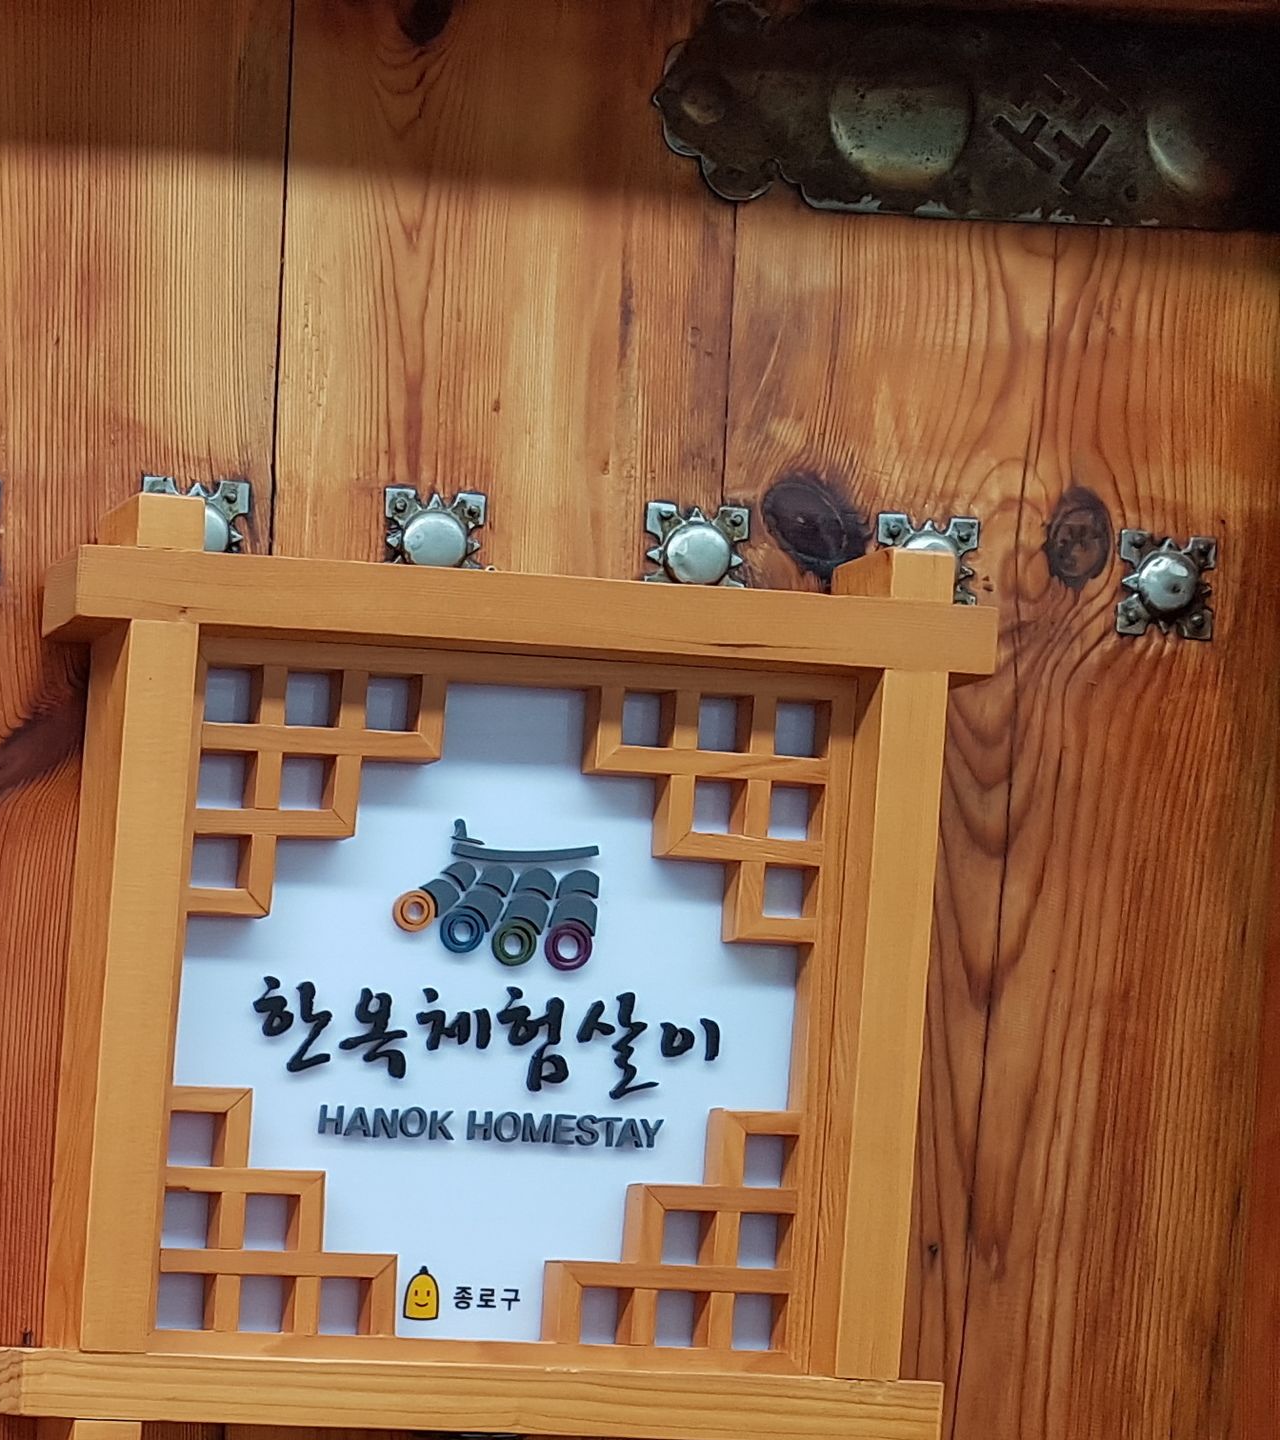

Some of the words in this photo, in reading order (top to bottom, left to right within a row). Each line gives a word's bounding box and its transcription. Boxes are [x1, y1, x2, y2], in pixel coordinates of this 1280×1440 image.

[253, 976, 721, 1099] 한옥체험살이
[317, 1104, 454, 1141] HANOK
[466, 1110, 664, 1149] HOMESTAY
[453, 1286, 522, 1312] 종로구
